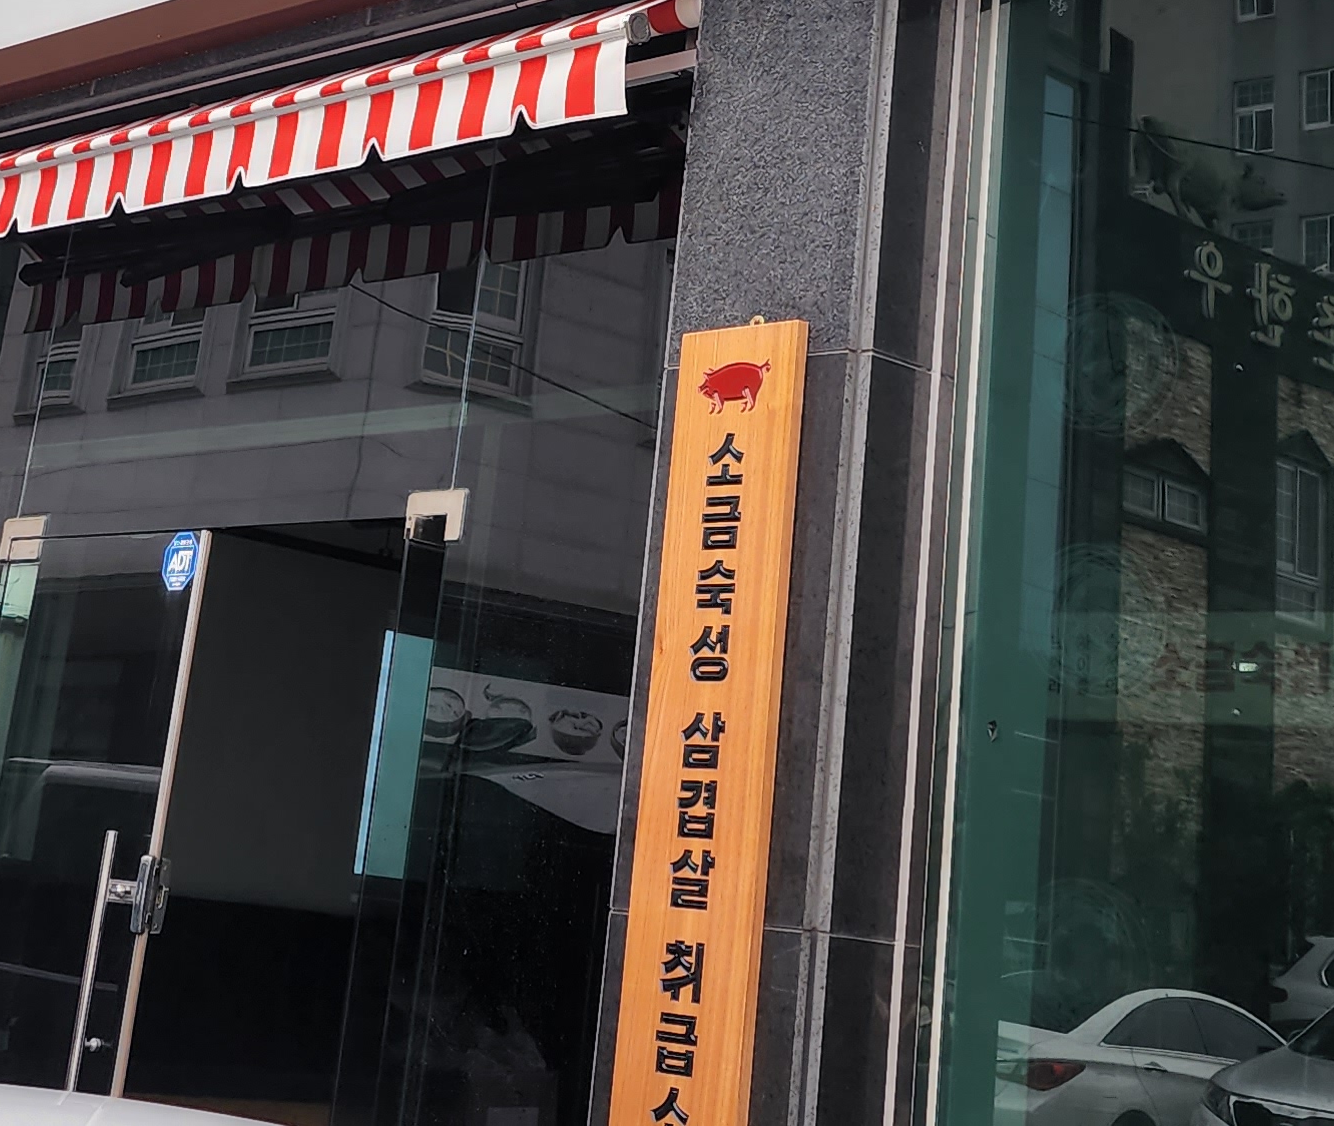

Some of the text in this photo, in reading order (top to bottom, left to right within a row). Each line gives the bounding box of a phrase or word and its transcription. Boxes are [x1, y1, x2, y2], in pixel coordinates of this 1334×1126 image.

[168, 550, 194, 574] ADT
[689, 432, 746, 683] 소금숙성
[669, 711, 727, 912] 삼겹살
